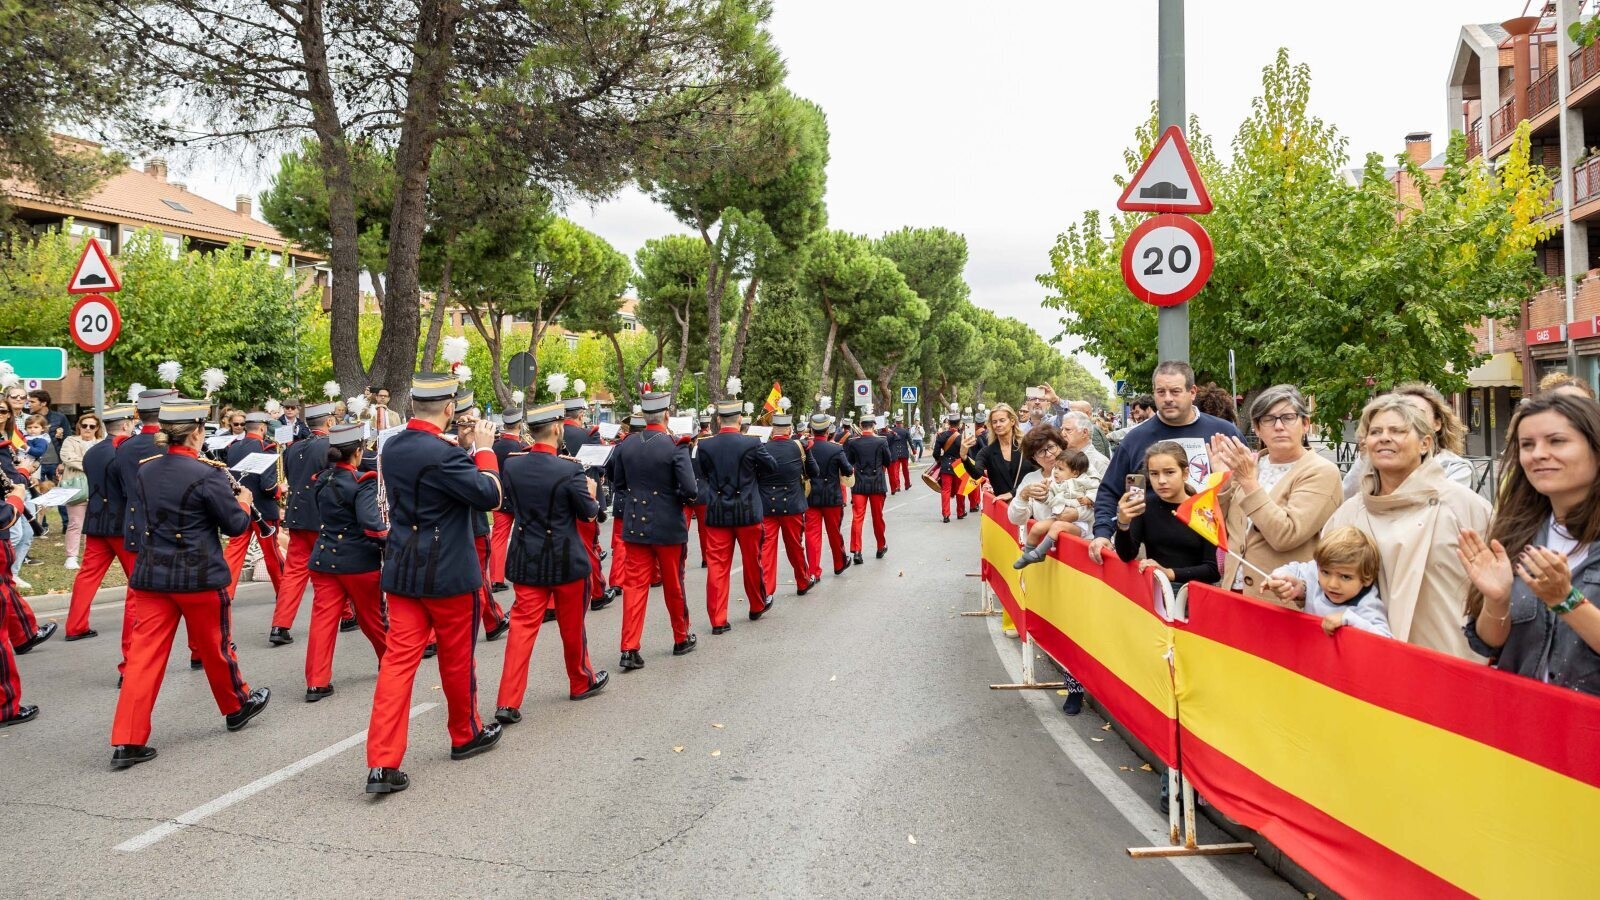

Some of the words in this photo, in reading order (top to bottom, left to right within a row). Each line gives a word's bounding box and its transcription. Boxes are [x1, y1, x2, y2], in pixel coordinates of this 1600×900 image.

[1142, 244, 1192, 276] 20
[81, 314, 108, 333] 20
[1536, 330, 1550, 341] GAES
